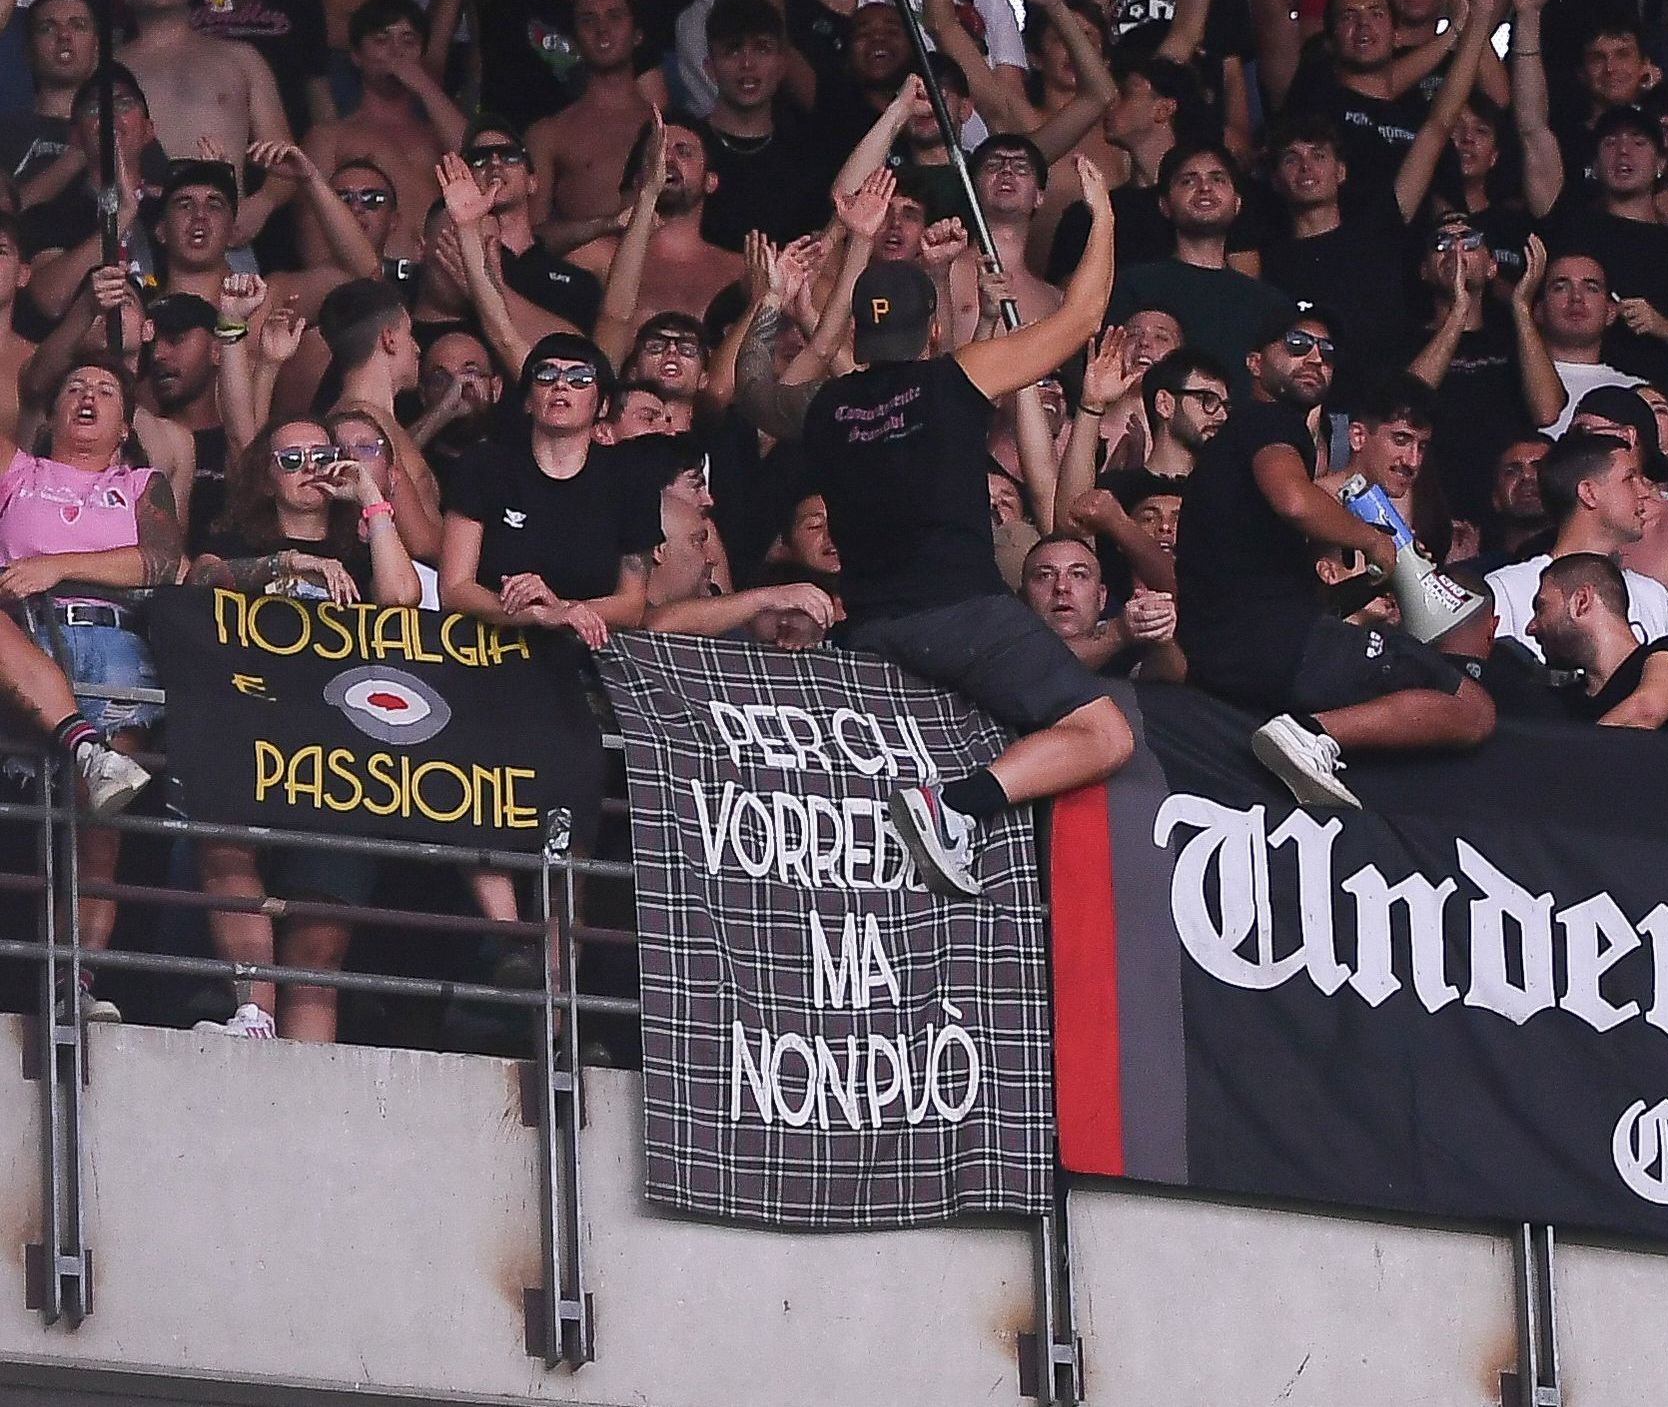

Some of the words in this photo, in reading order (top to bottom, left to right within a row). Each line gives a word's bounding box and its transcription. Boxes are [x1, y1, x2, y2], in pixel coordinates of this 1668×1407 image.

[871, 298, 890, 324] P
[212, 587, 532, 668] NOSTALGIA
[254, 739, 540, 829] PASSIONE
[708, 699, 832, 772] PER
[831, 707, 938, 784] CHI
[809, 909, 900, 1009] MA
[730, 1020, 862, 1130] NON
[865, 996, 980, 1130] PUÒ
